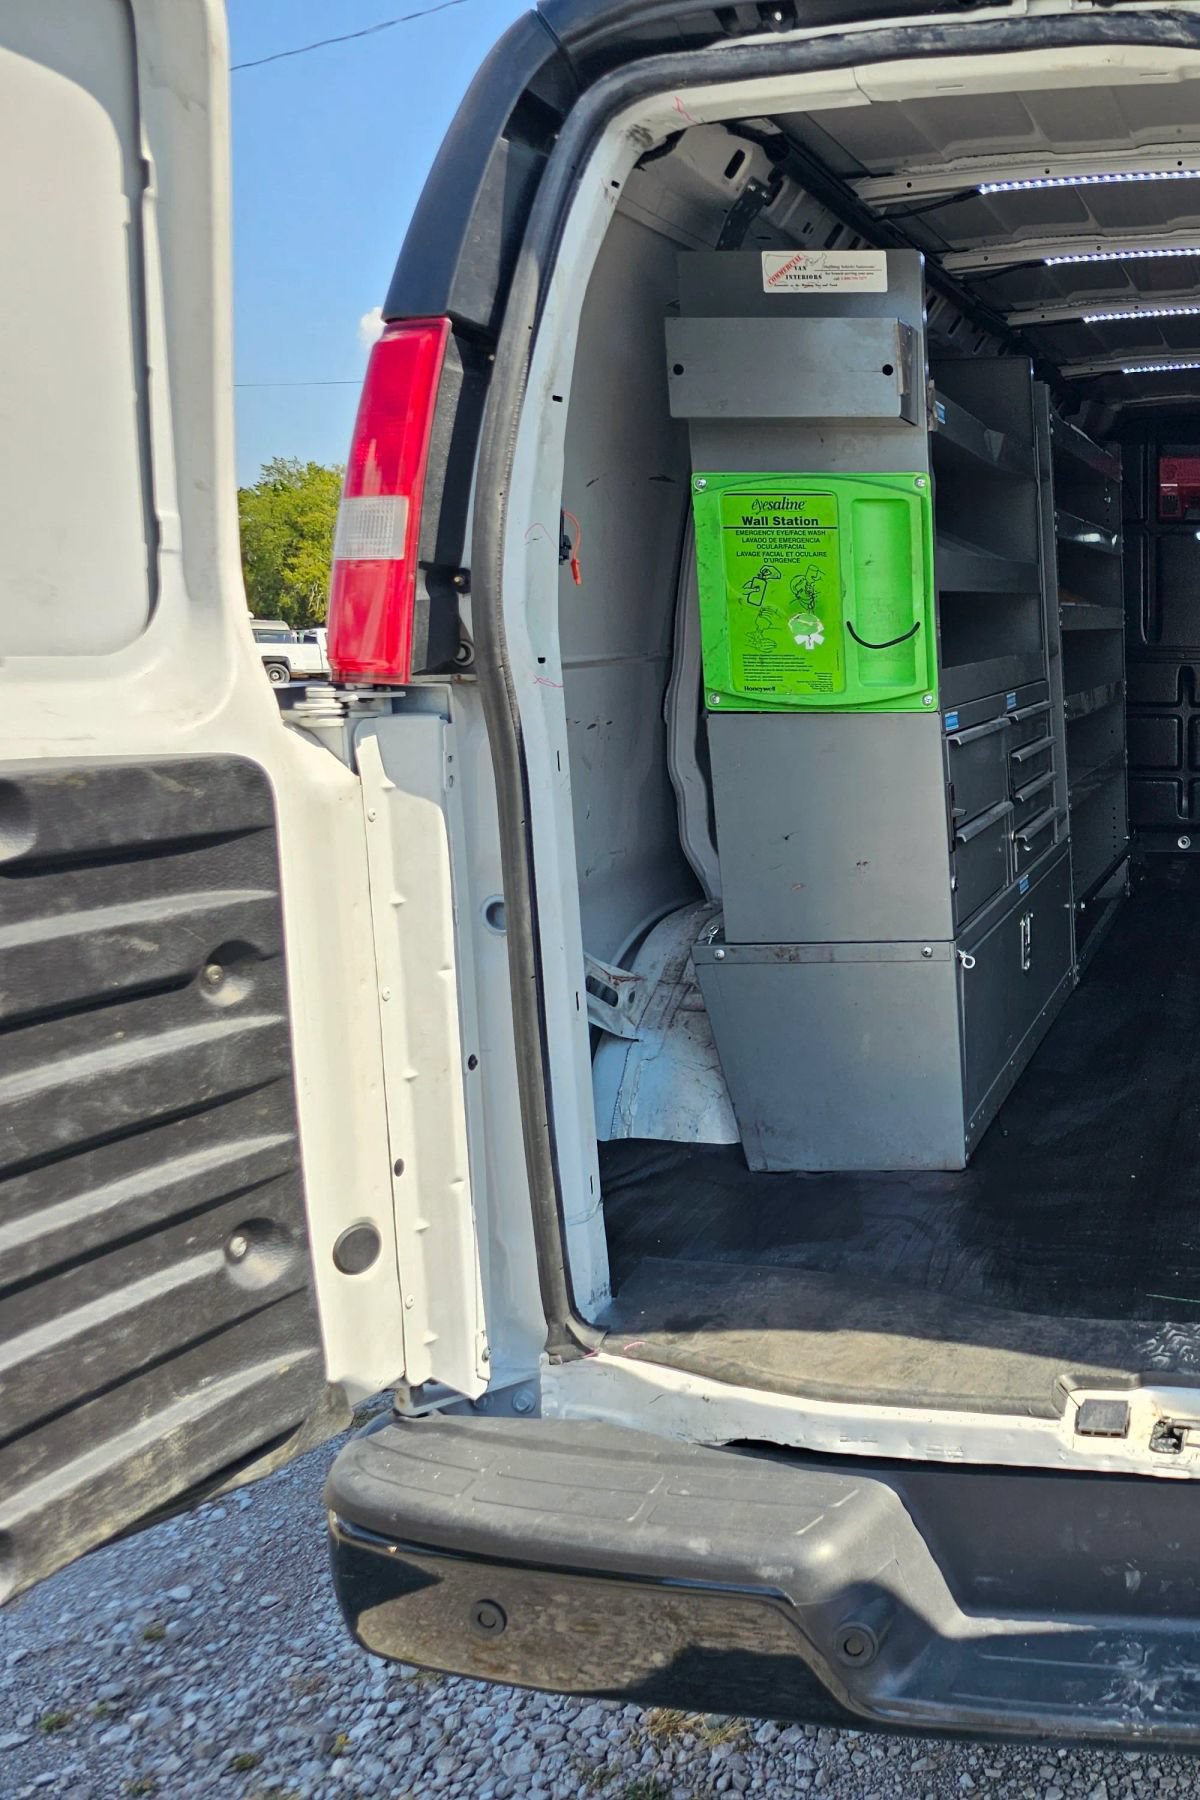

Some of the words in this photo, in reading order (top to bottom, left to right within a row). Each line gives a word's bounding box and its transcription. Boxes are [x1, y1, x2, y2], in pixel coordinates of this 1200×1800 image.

[751, 496, 806, 515] eyesaline
[741, 516, 769, 526] Wall
[772, 516, 819, 526] Station
